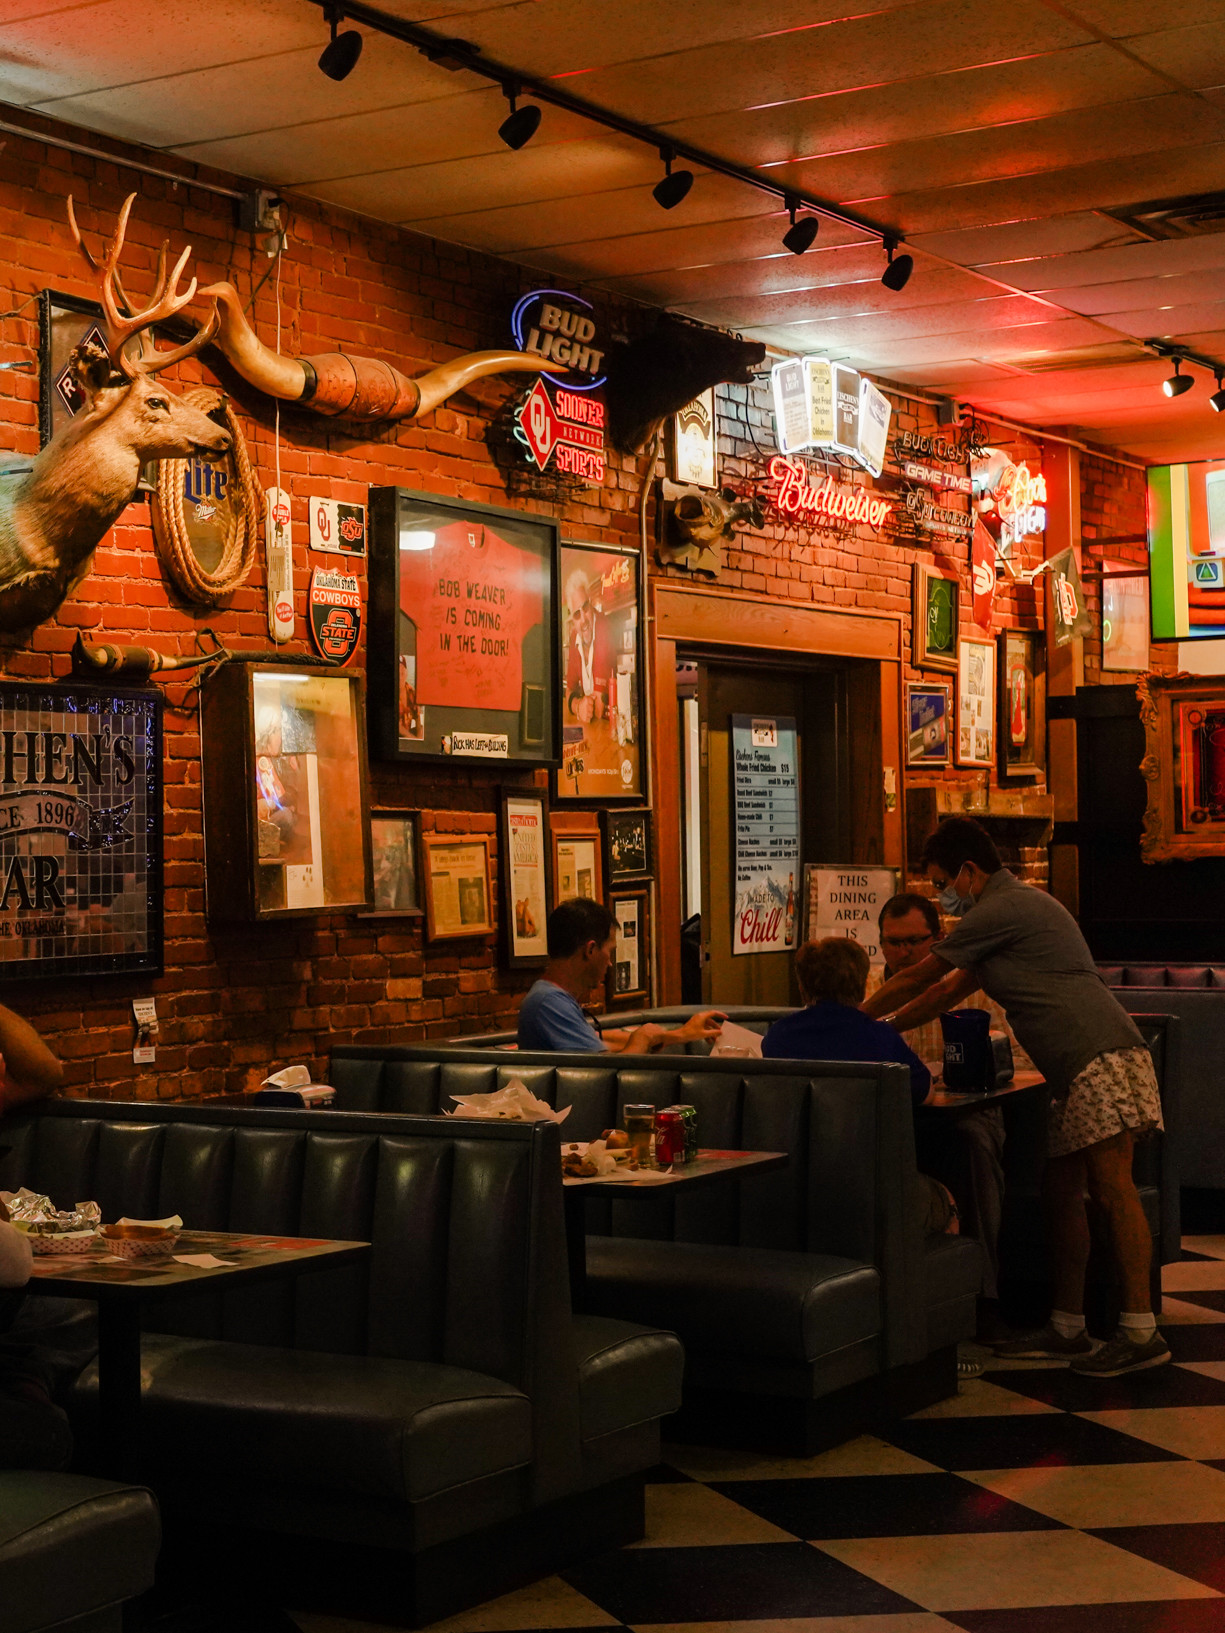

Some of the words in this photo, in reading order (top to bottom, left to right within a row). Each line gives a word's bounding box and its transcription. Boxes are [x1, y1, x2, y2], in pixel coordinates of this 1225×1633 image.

[540, 304, 595, 343] BUD
[526, 328, 604, 375] LIGHT
[556, 390, 605, 428] SOONER
[530, 394, 551, 454] OU
[563, 427, 602, 447] NETWORK
[556, 443, 605, 481] SPORTS
[906, 463, 943, 484] GAME
[943, 471, 971, 491] TIME
[770, 457, 891, 525] Budweiser
[195, 503, 217, 519] Miller
[317, 507, 330, 541] OU
[340, 517, 363, 541] OSU
[316, 576, 341, 588] OKLAHOMA
[341, 579, 356, 591] STATE
[439, 579, 460, 598] BOB
[466, 581, 505, 605] WEAVER
[312, 590, 361, 606] COWBOYS
[446, 607, 457, 624] IS
[464, 609, 501, 630] COMING
[321, 626, 355, 638] STATE
[439, 633, 451, 652] IN
[456, 635, 476, 653] THE
[481, 637, 509, 657] DOOR!
[465, 739, 475, 750] HAS
[749, 763, 759, 771] Fried
[760, 763, 776, 772] Chicken
[36, 802, 74, 827] 1896
[838, 875, 868, 886] THIS
[830, 892, 876, 904] DINING
[15, 917, 66, 937] OKLAHOMA
[740, 907, 783, 944] Chill
[835, 910, 870, 920] AREA
[845, 928, 857, 939] IS
